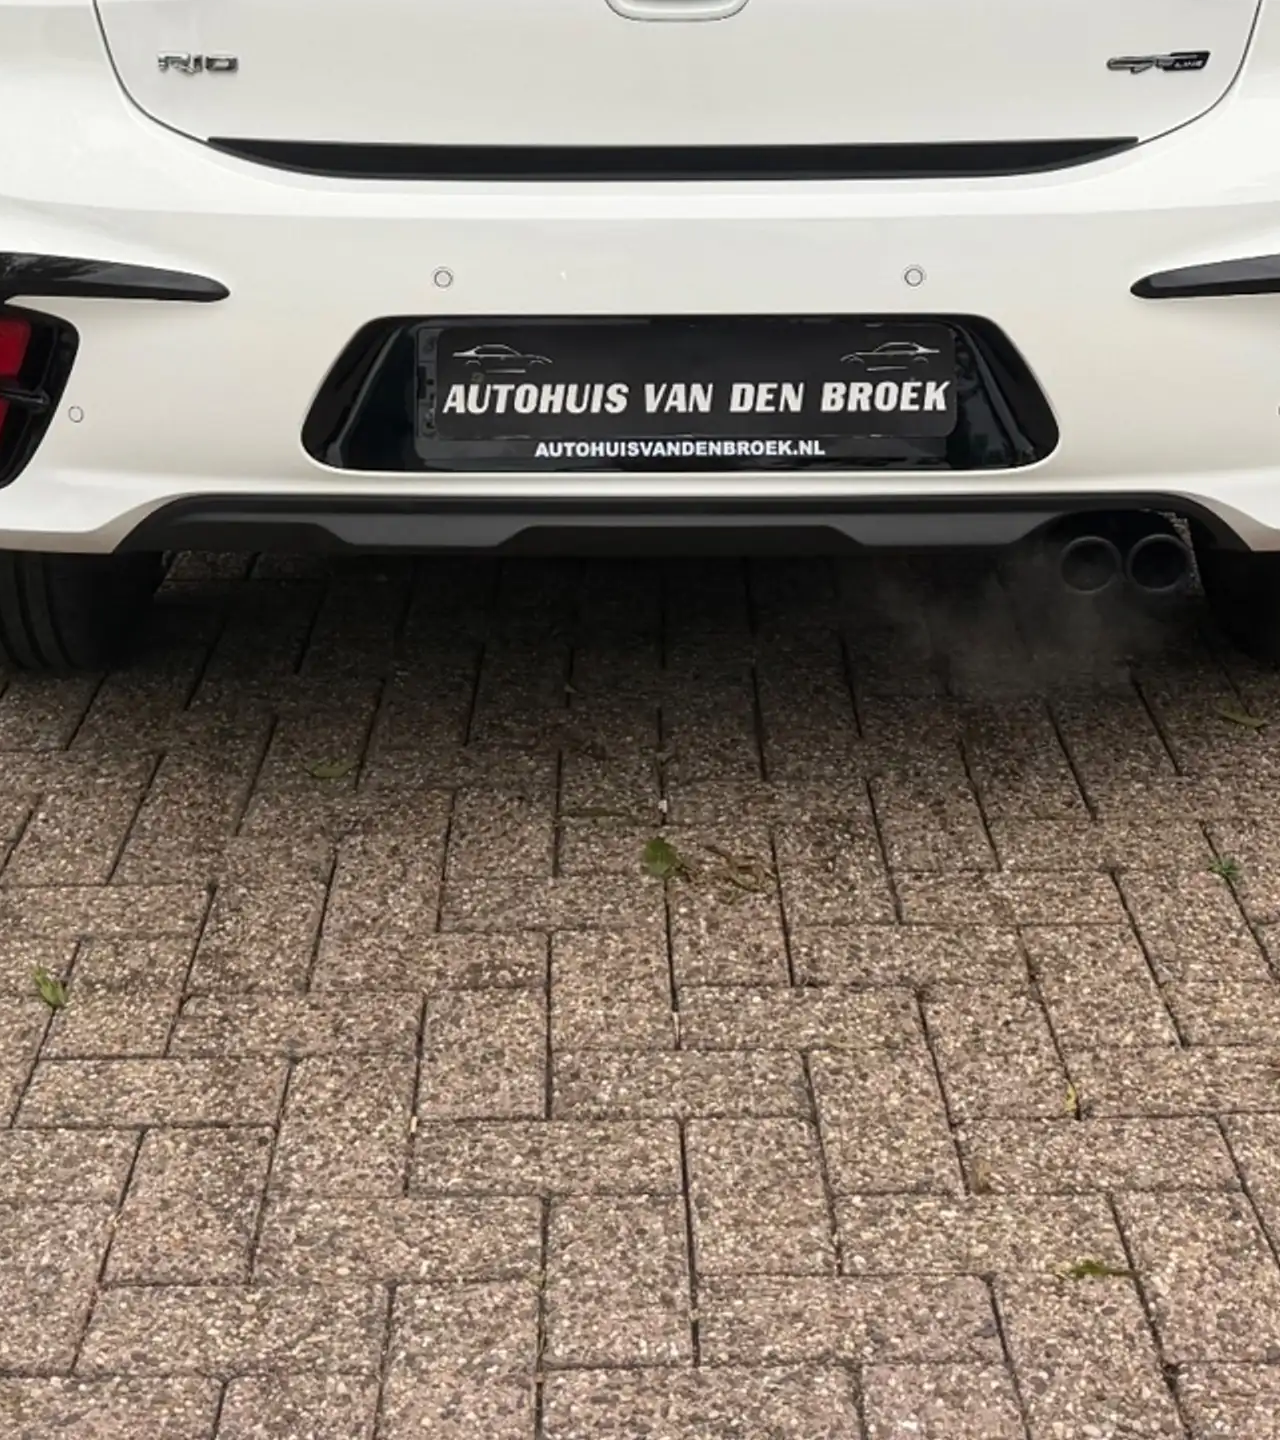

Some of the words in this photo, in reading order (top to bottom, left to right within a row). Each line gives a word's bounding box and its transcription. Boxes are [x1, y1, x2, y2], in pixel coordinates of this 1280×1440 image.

[442, 382, 630, 415] AUTOHUIS
[644, 382, 714, 413] VAN
[729, 382, 805, 413] DEN
[820, 380, 951, 412] BROEK
[534, 439, 826, 458] AUTOHUISVANDENBROEK.NL
